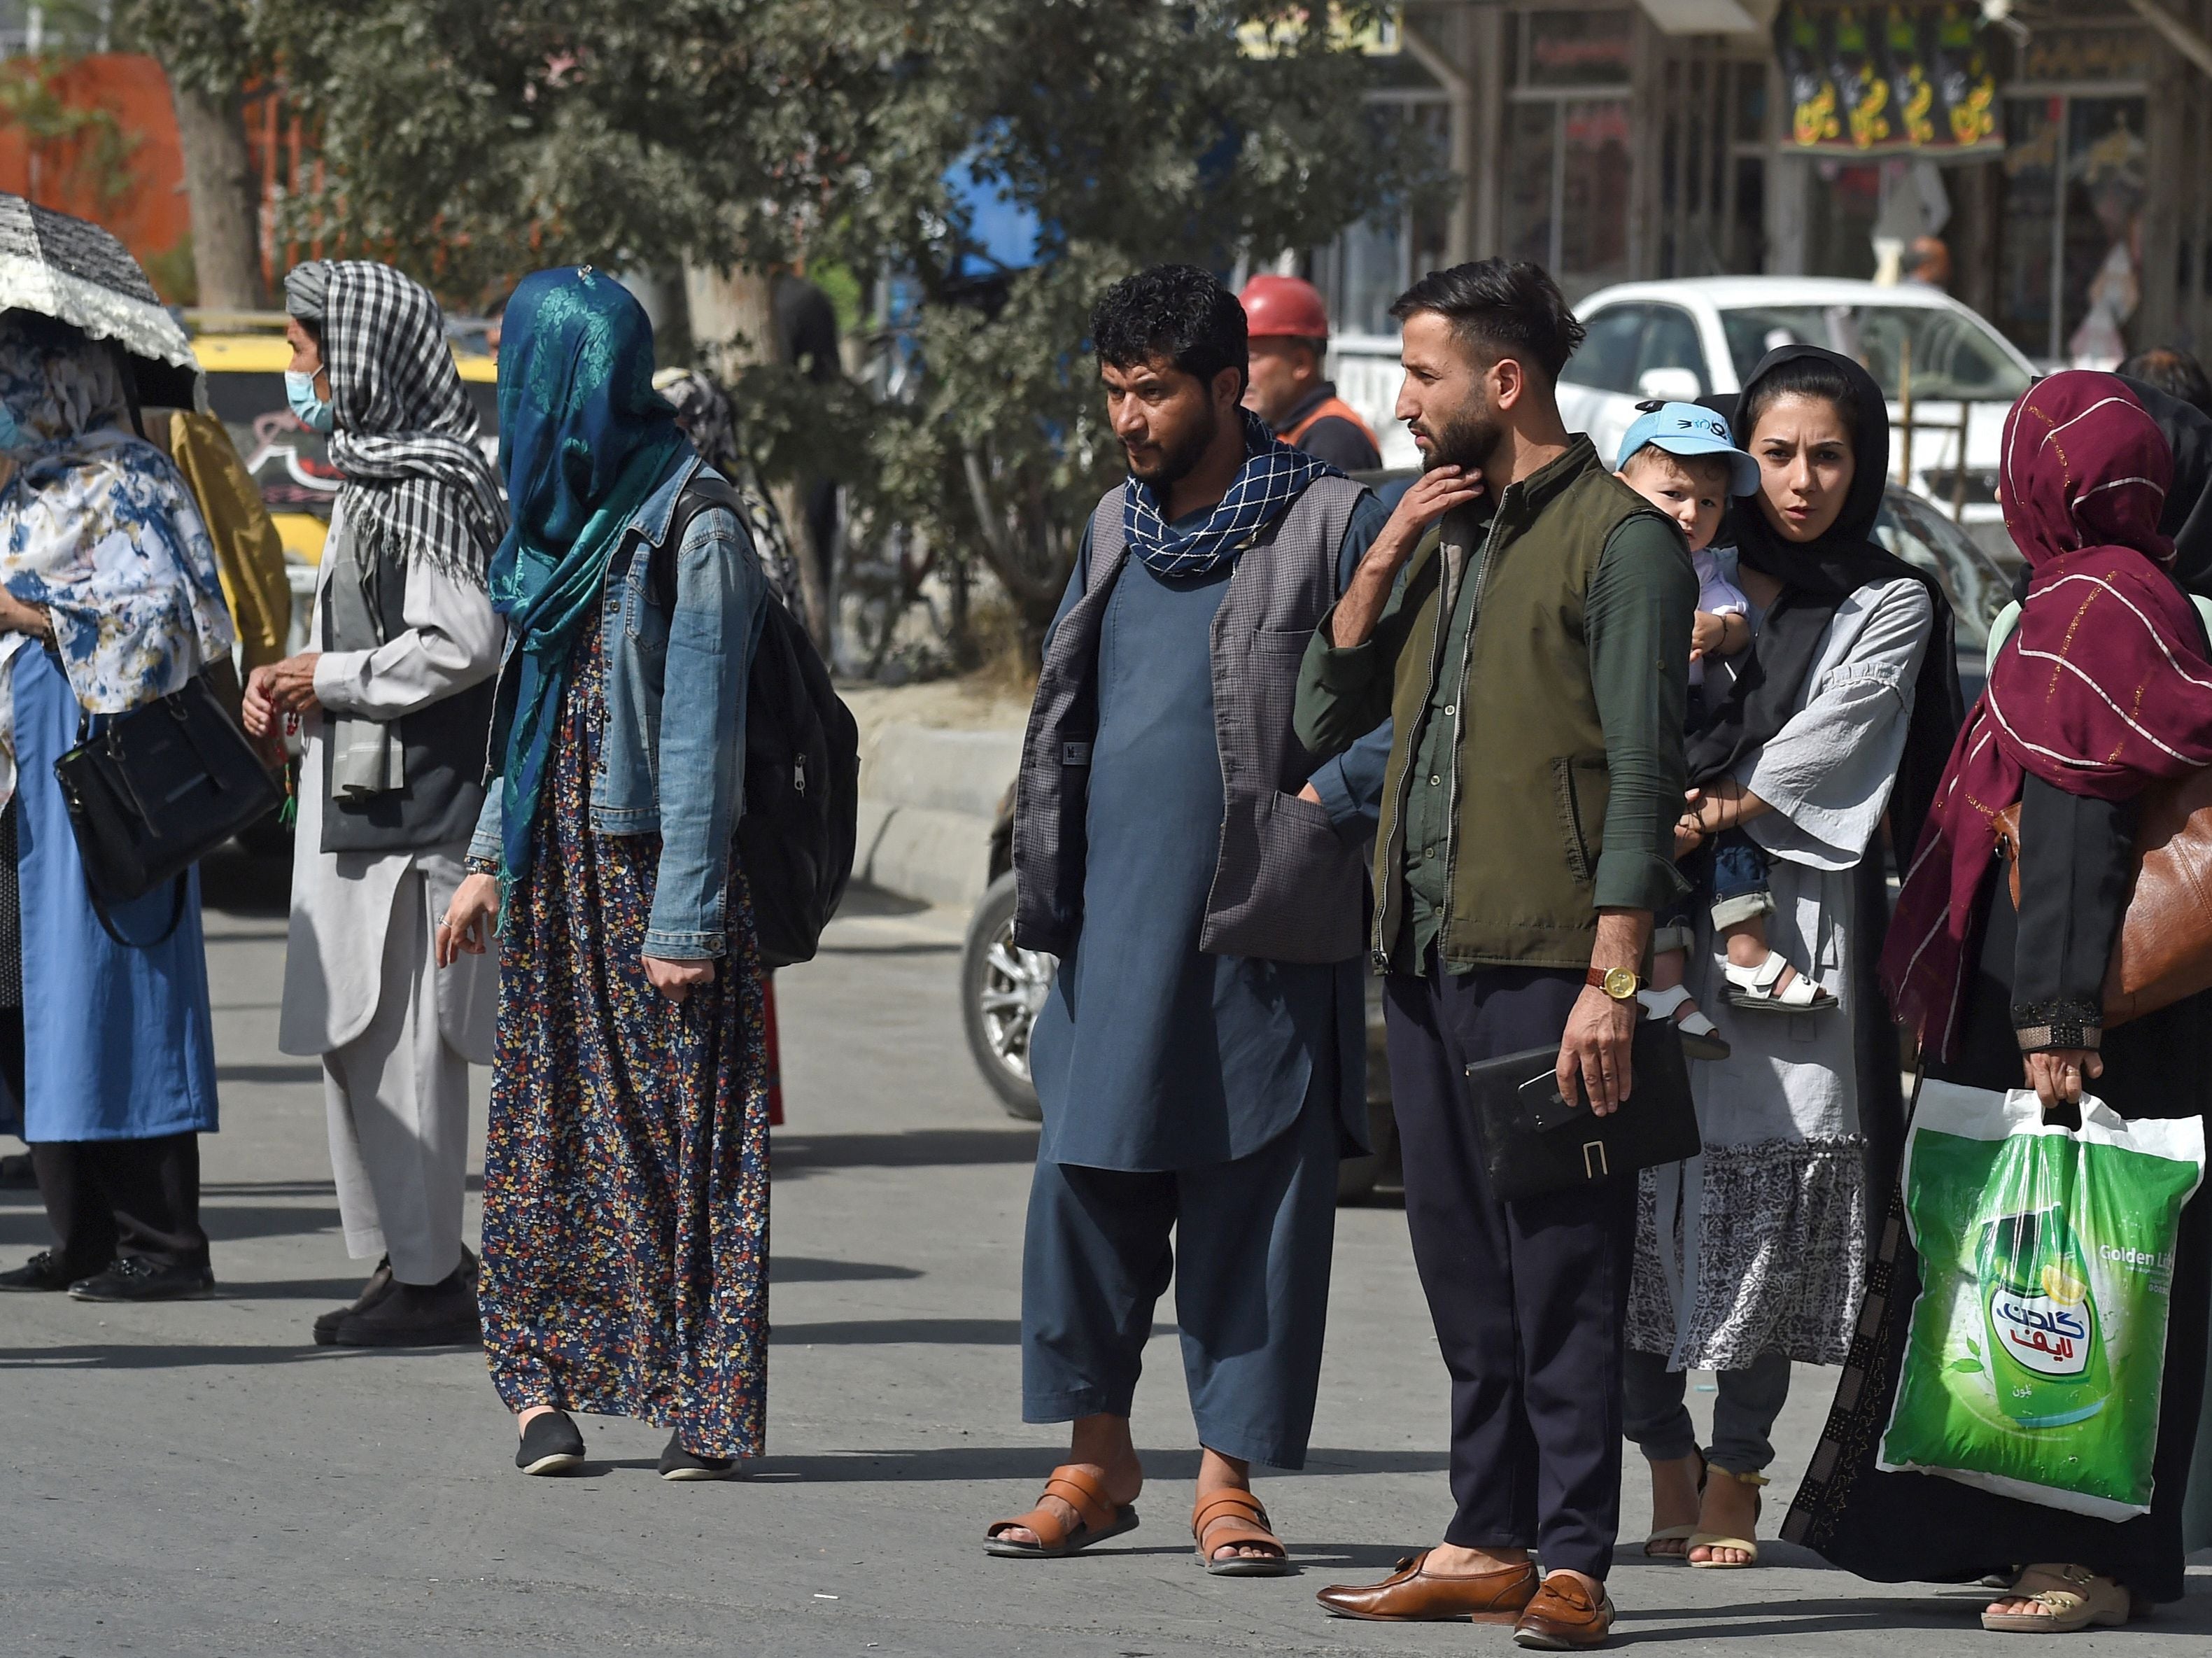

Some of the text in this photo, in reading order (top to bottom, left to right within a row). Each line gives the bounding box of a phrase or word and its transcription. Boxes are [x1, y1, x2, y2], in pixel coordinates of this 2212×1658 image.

[2099, 1244, 2171, 1270] Golden Lif
[2003, 1302, 2085, 1340] گلدن
